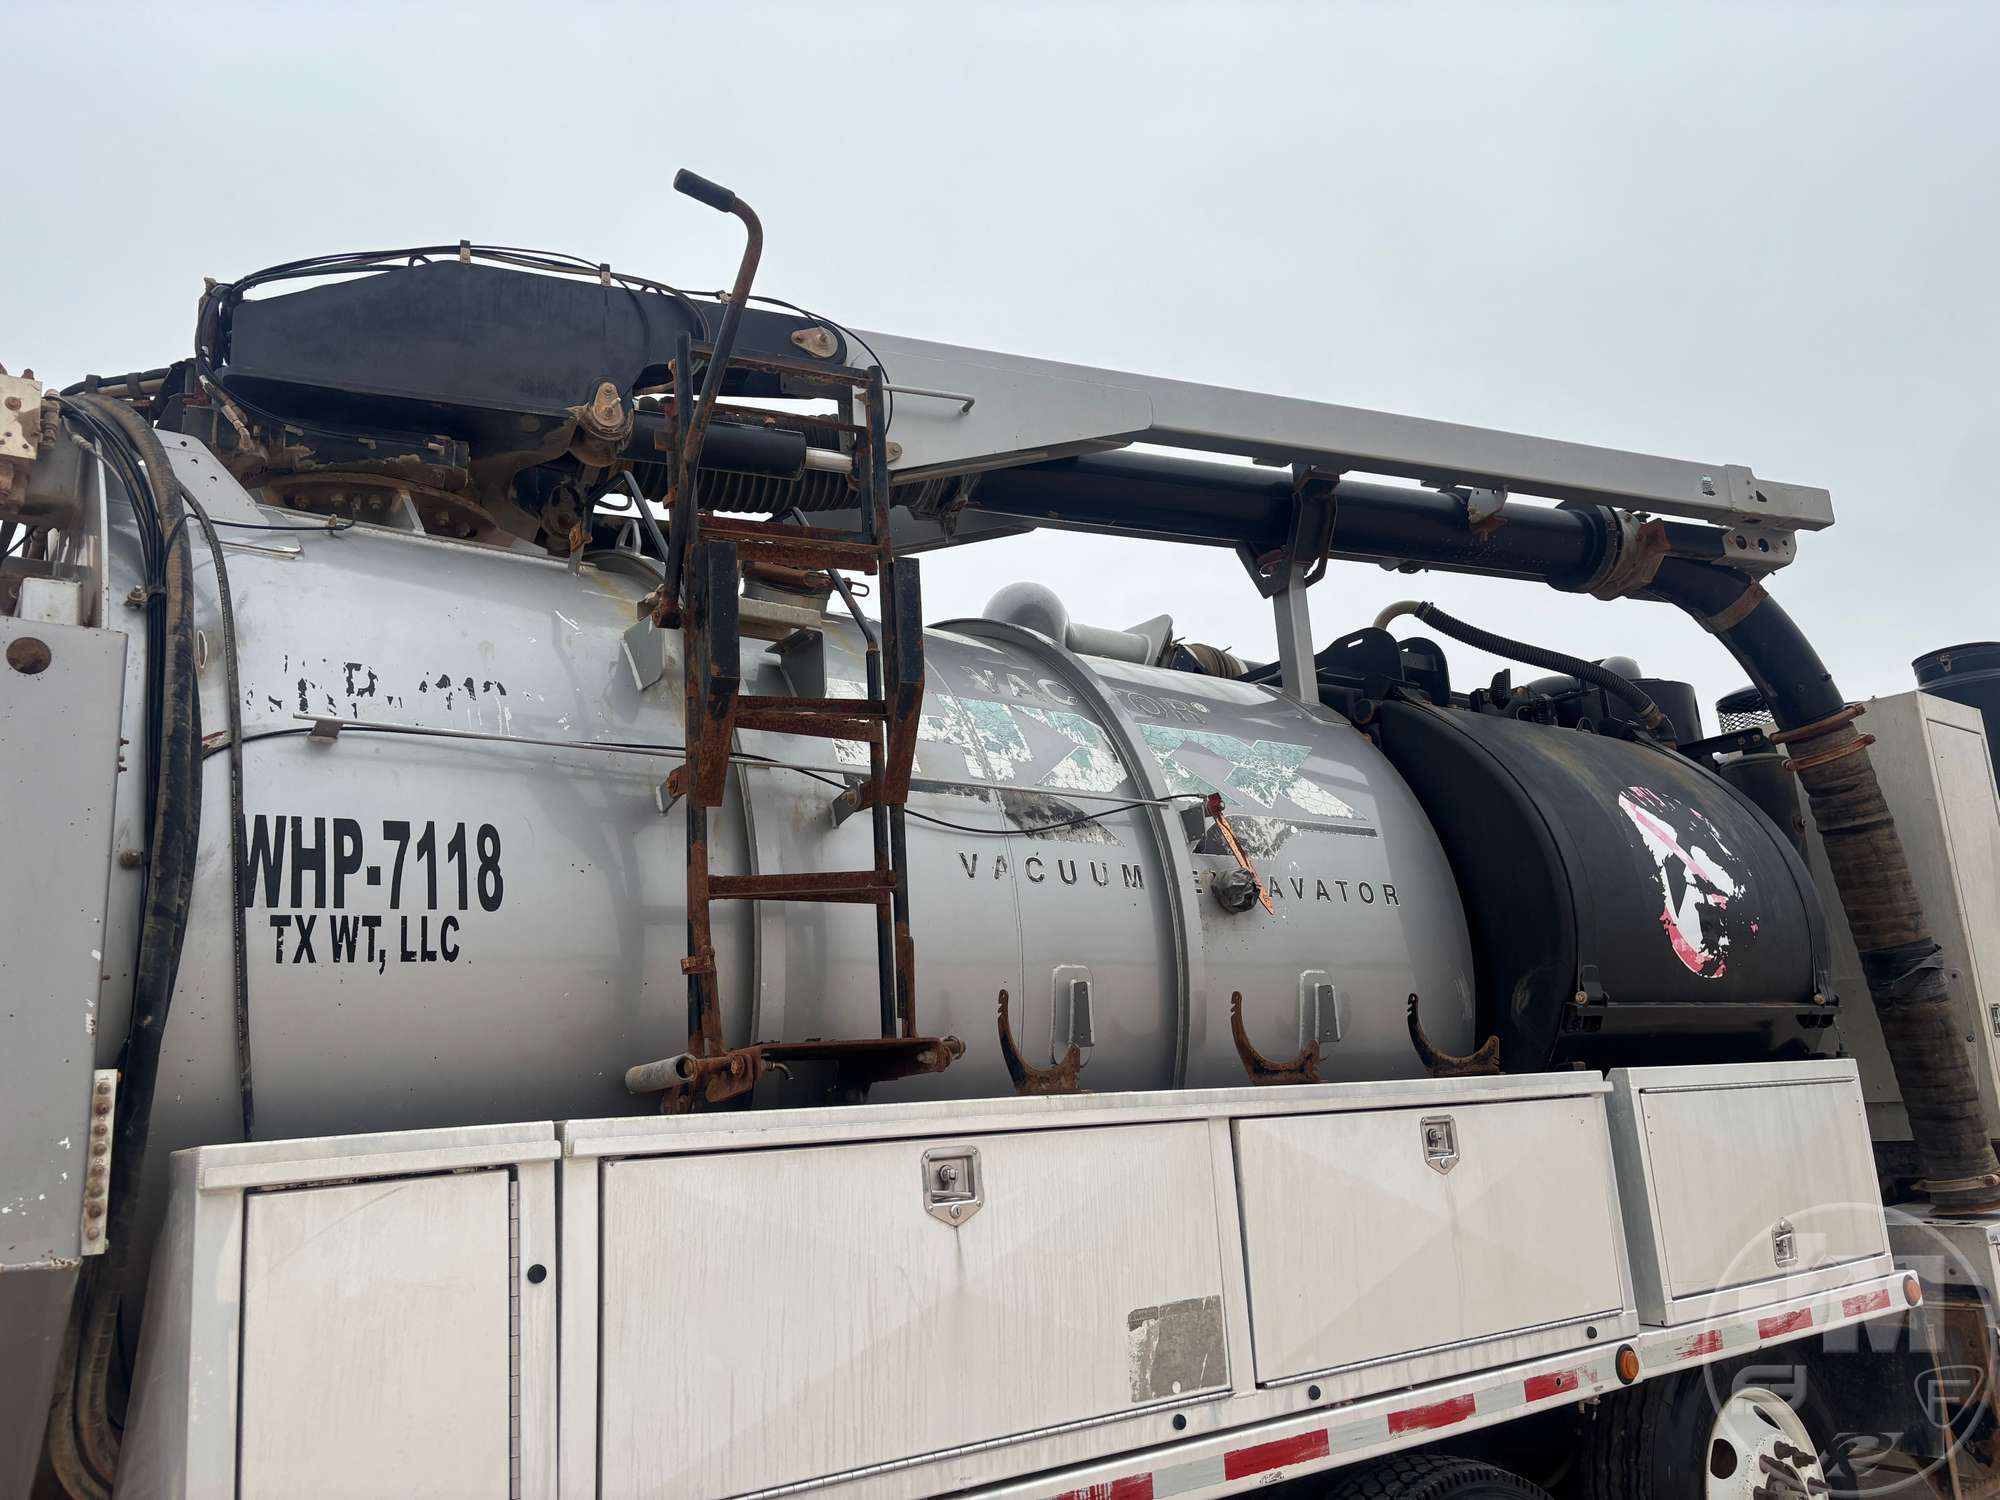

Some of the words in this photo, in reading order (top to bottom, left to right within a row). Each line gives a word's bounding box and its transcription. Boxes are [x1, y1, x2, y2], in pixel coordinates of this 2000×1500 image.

[241, 814, 504, 912] WHP-7118
[957, 851, 1145, 890] VACUUM
[269, 914, 317, 963] TX
[329, 914, 386, 975] WT,
[400, 915, 460, 963] LLC
